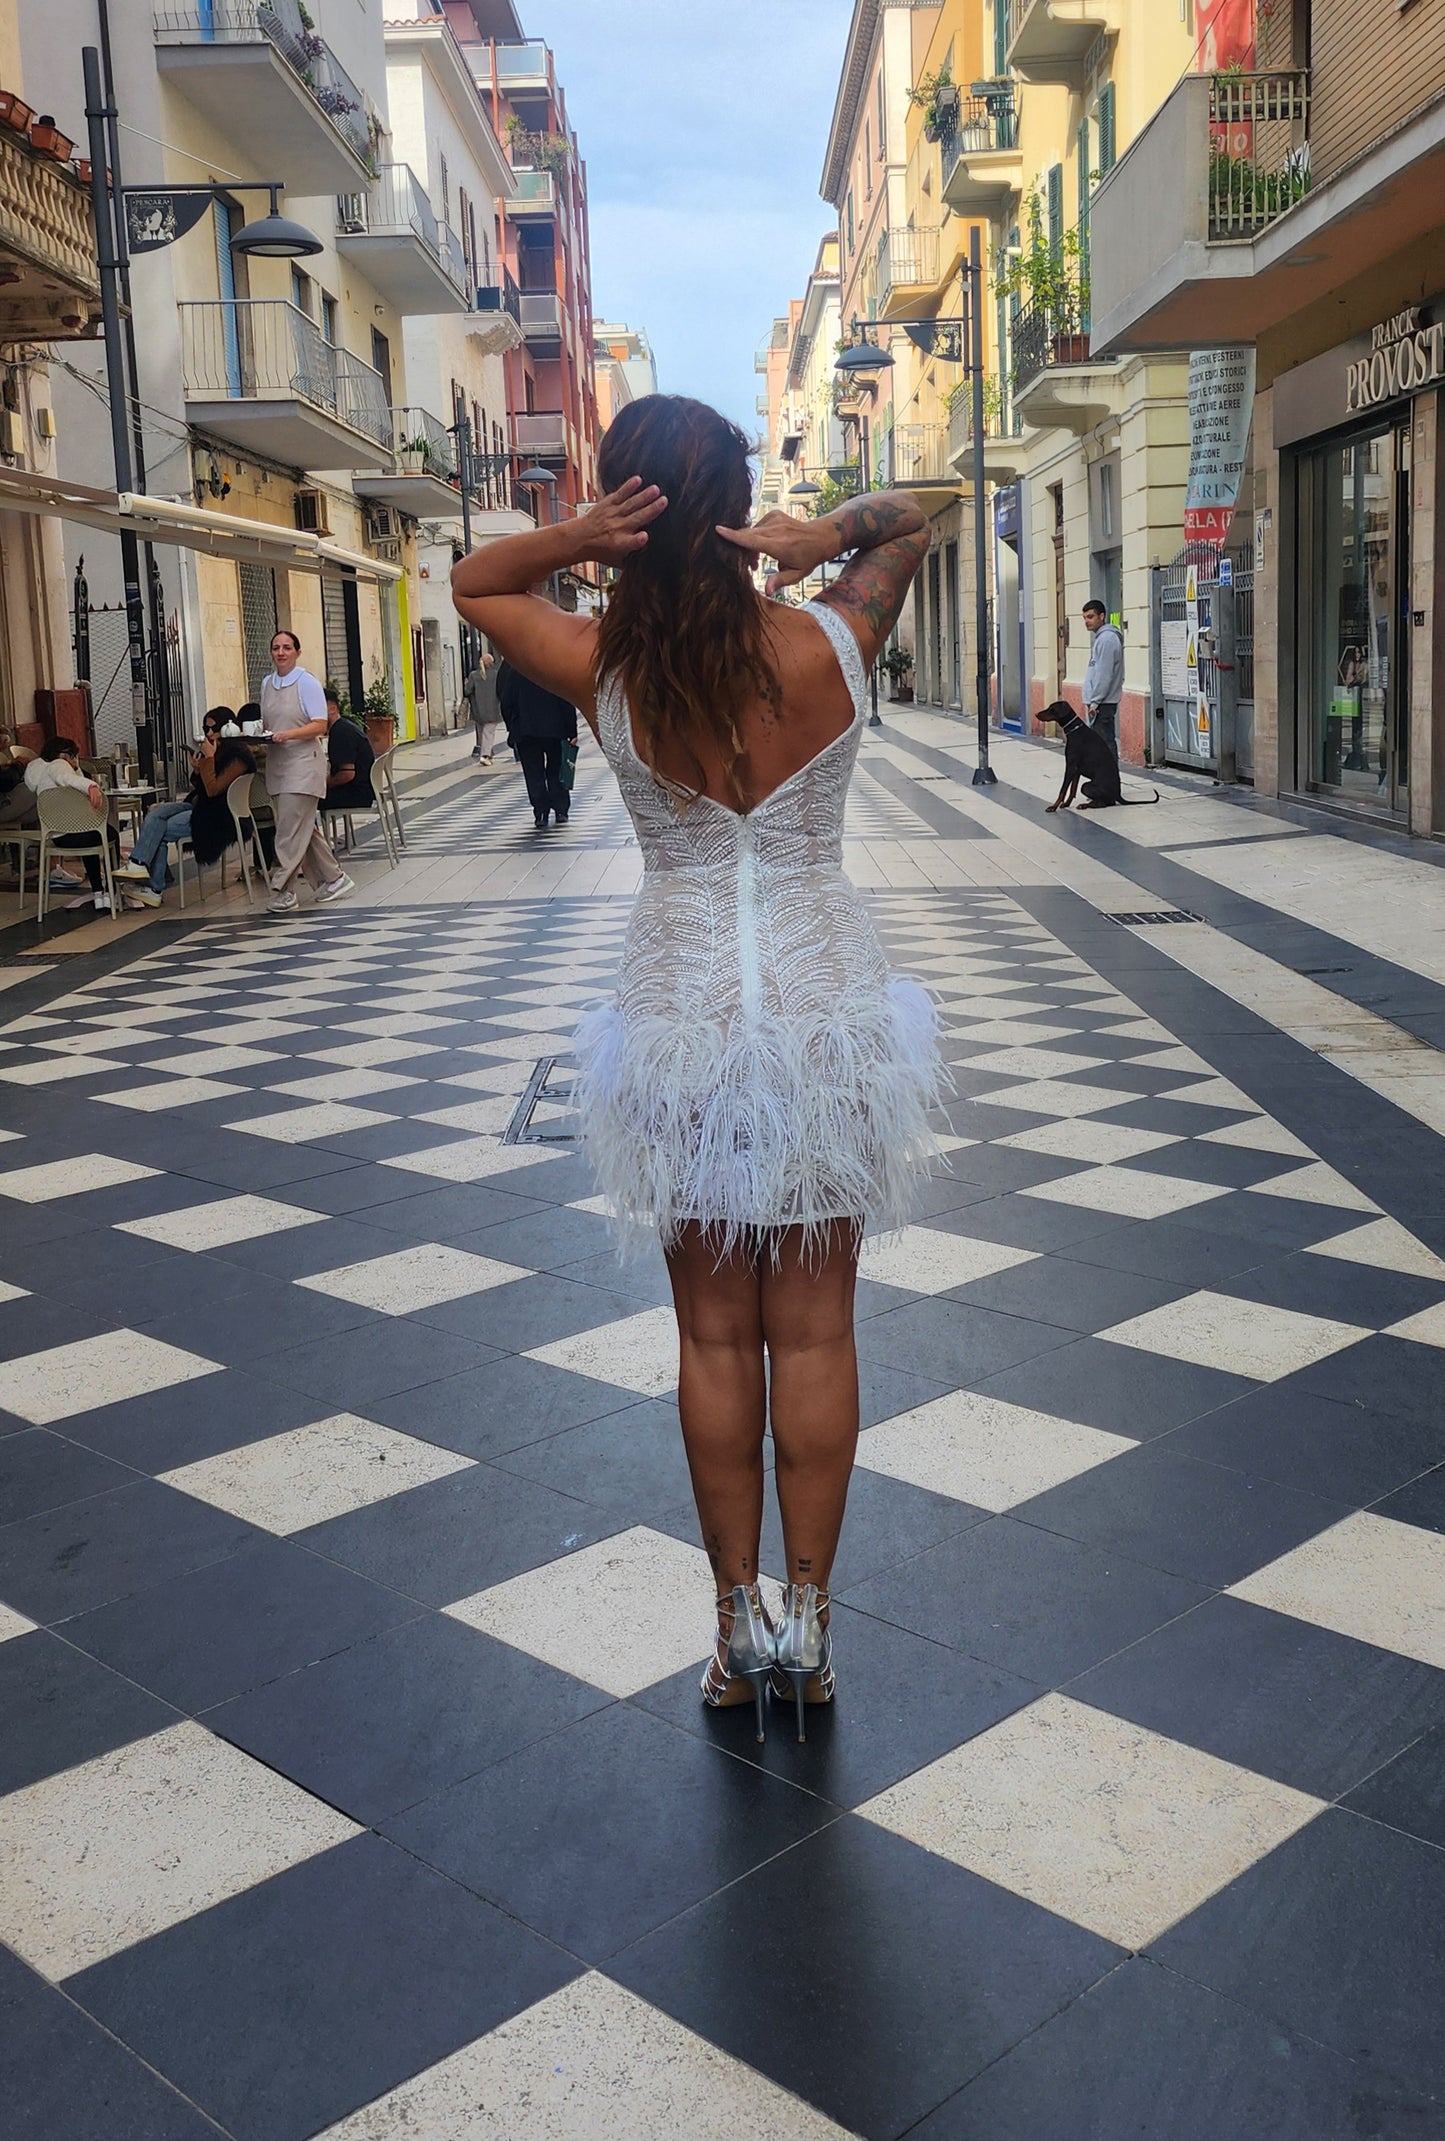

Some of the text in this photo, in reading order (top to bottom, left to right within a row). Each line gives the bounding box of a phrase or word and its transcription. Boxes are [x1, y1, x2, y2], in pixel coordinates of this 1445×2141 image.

[1372, 307, 1416, 350] FRANCK
[1345, 322, 1443, 413] PROVOST
[1218, 398, 1241, 410] AEREE
